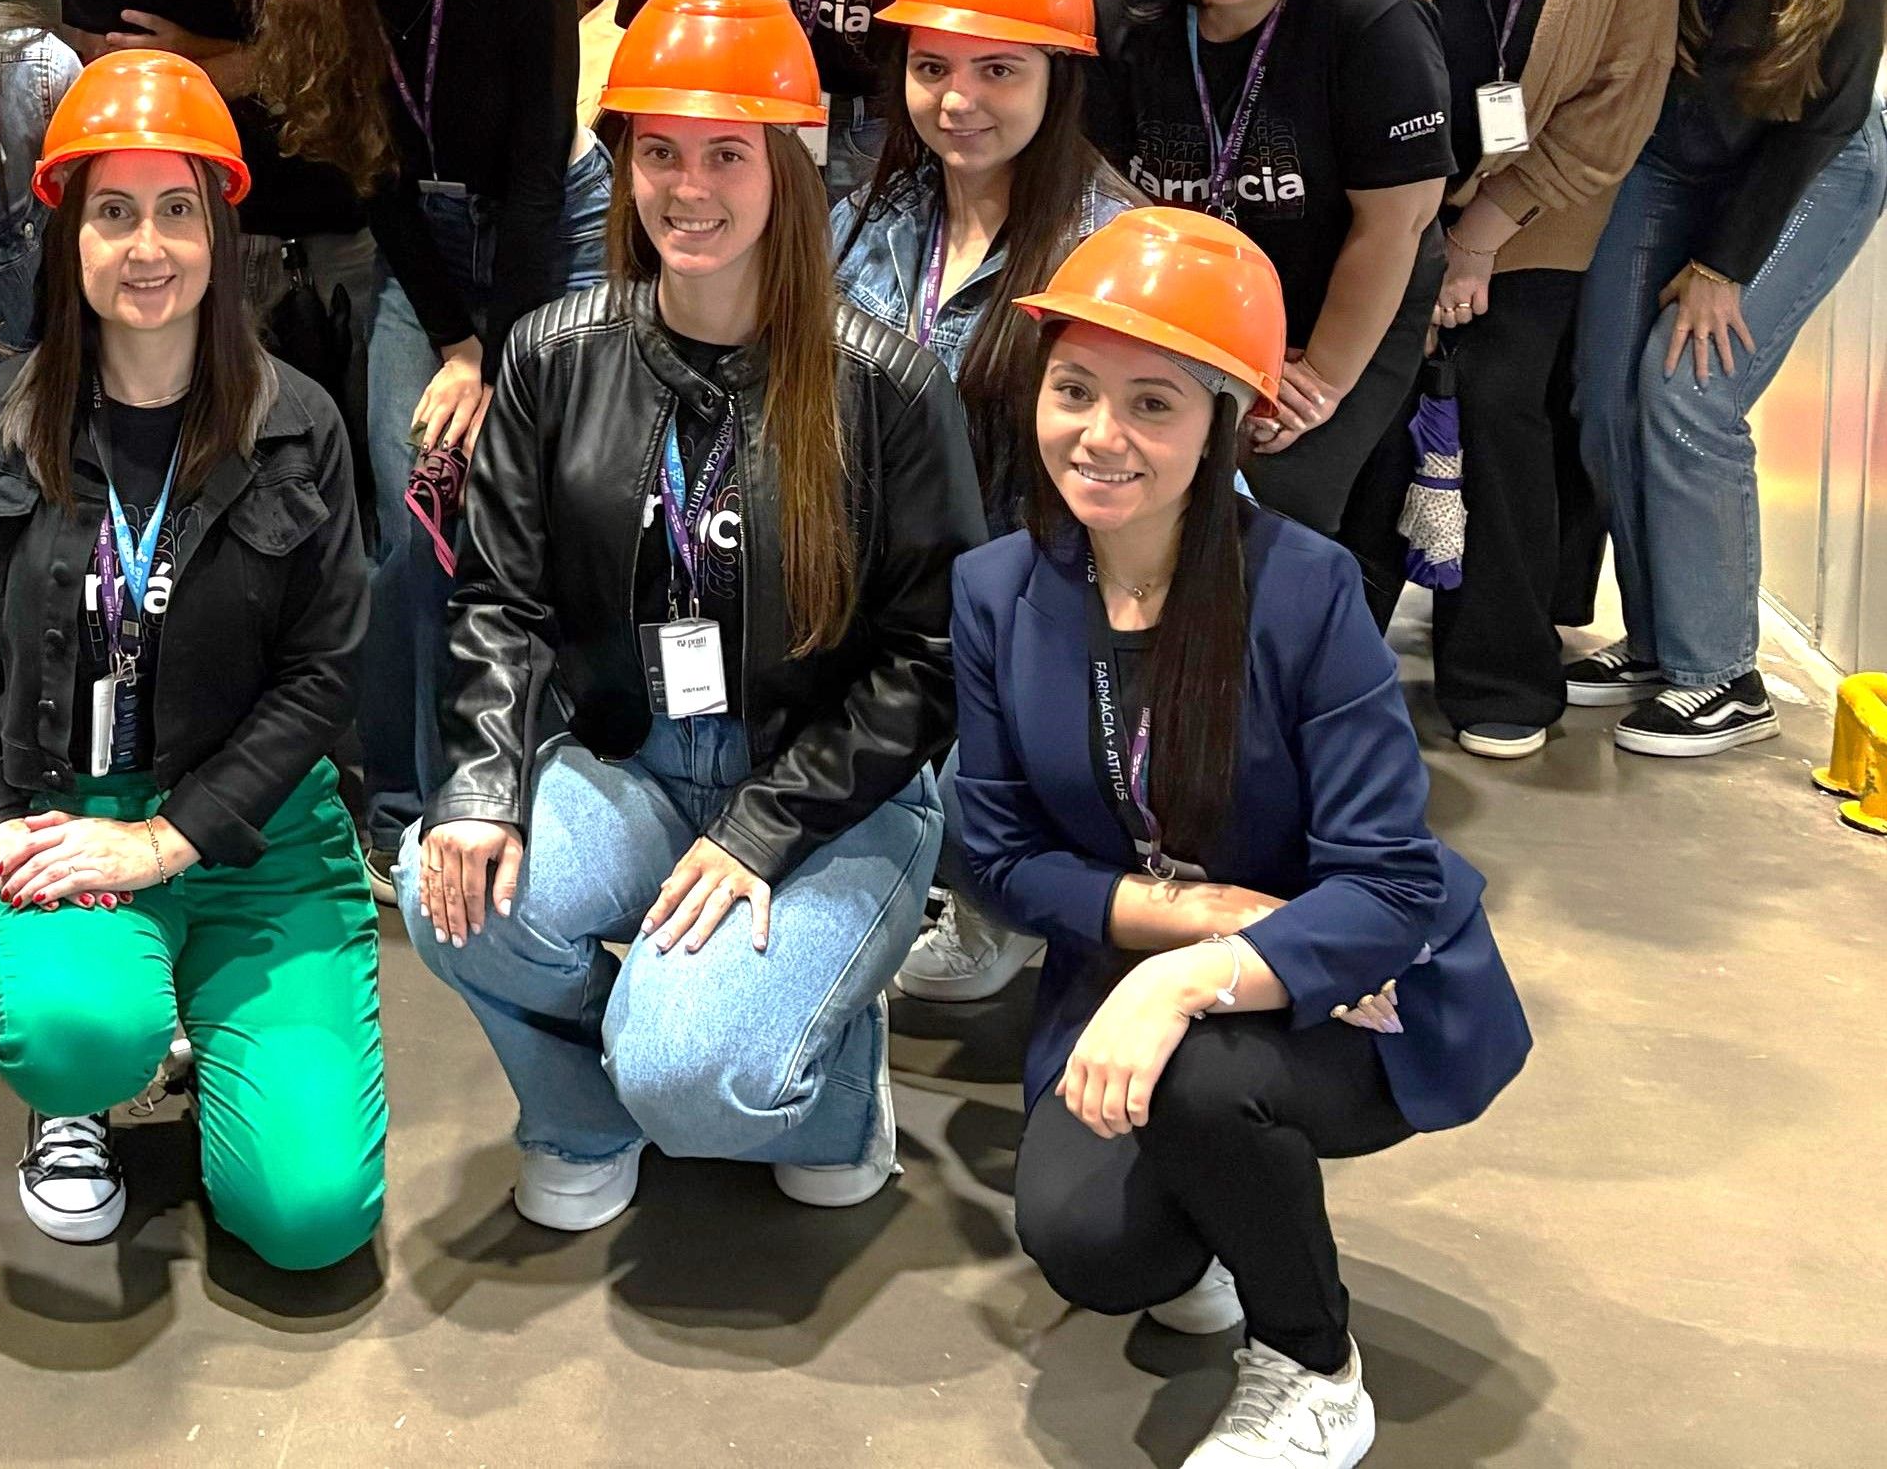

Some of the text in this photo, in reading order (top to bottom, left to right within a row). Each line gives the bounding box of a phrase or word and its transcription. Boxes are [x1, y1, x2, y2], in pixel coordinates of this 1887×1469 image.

[1389, 111, 1445, 139] ATITUS
[1129, 155, 1306, 203] farmcia
[683, 481, 708, 528] ATITUS
[1094, 661, 1115, 739] FARMÁCIA
[1106, 749, 1129, 801] ATITUS
